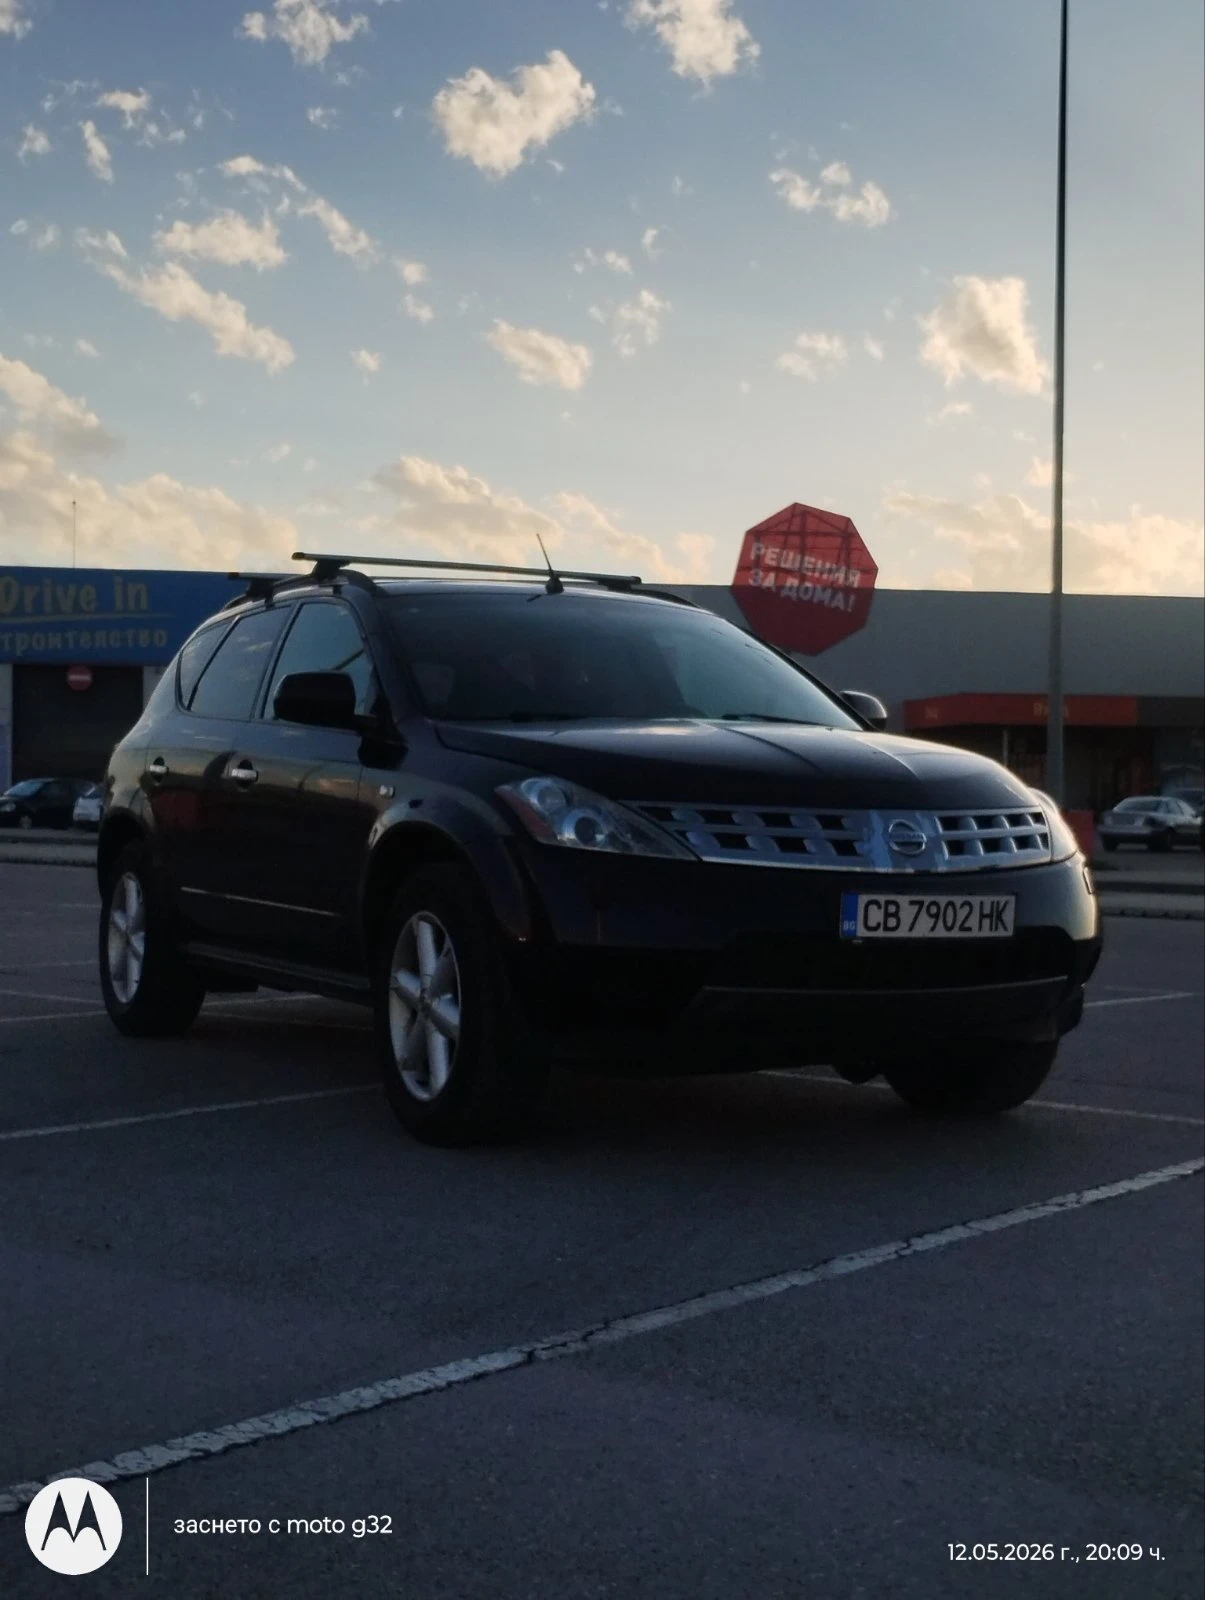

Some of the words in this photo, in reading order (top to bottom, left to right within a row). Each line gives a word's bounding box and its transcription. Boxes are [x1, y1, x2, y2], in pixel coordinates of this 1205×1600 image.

[750, 541, 861, 588] РЕШЕНИЯ
[0, 576, 98, 615] Drive
[113, 575, 149, 611] in
[748, 569, 776, 592] ЗА
[780, 577, 856, 612] ДОМА!
